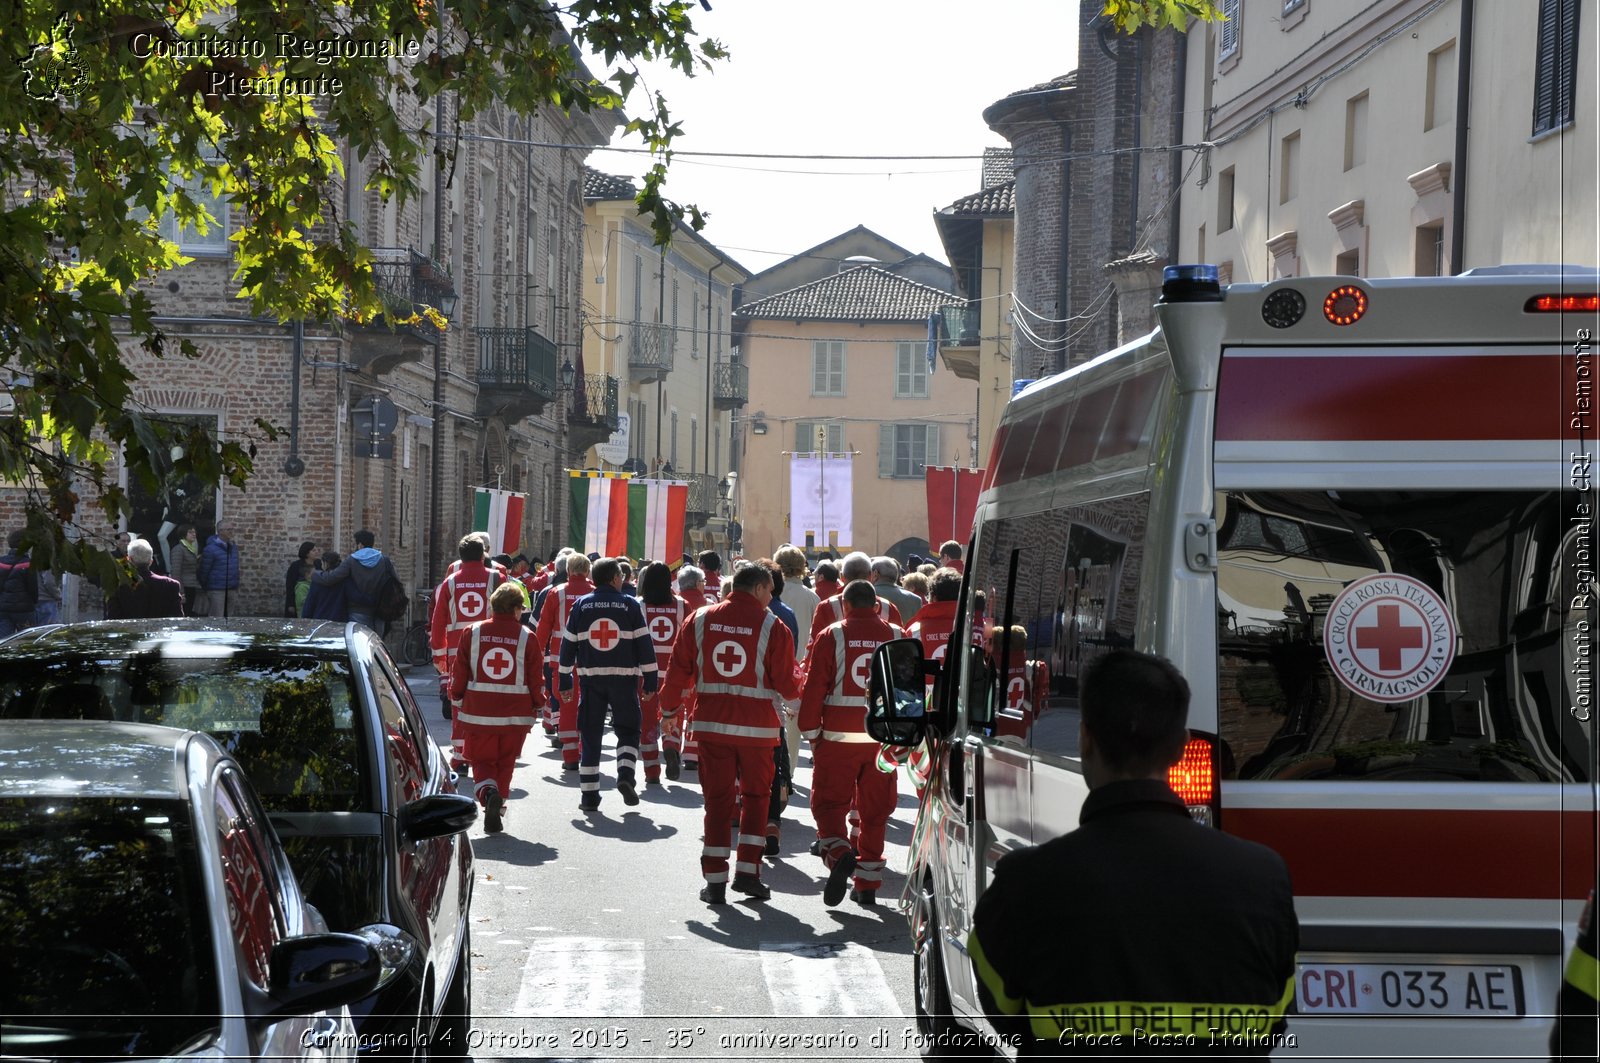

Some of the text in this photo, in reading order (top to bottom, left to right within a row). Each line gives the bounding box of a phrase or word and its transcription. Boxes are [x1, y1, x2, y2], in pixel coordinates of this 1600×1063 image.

[595, 601, 610, 609] ROSSA
[1332, 581, 1447, 645] CROCE ROSSA ITALIANA
[848, 640, 862, 648] CROCE
[862, 640, 875, 648] ROSSA
[926, 633, 939, 641] CROCE
[1339, 655, 1445, 695] CARMAGNOLA
[1301, 969, 1508, 1011] CRI 033 AE
[1048, 1005, 1270, 1036] VIGILI DEL FUOCO
